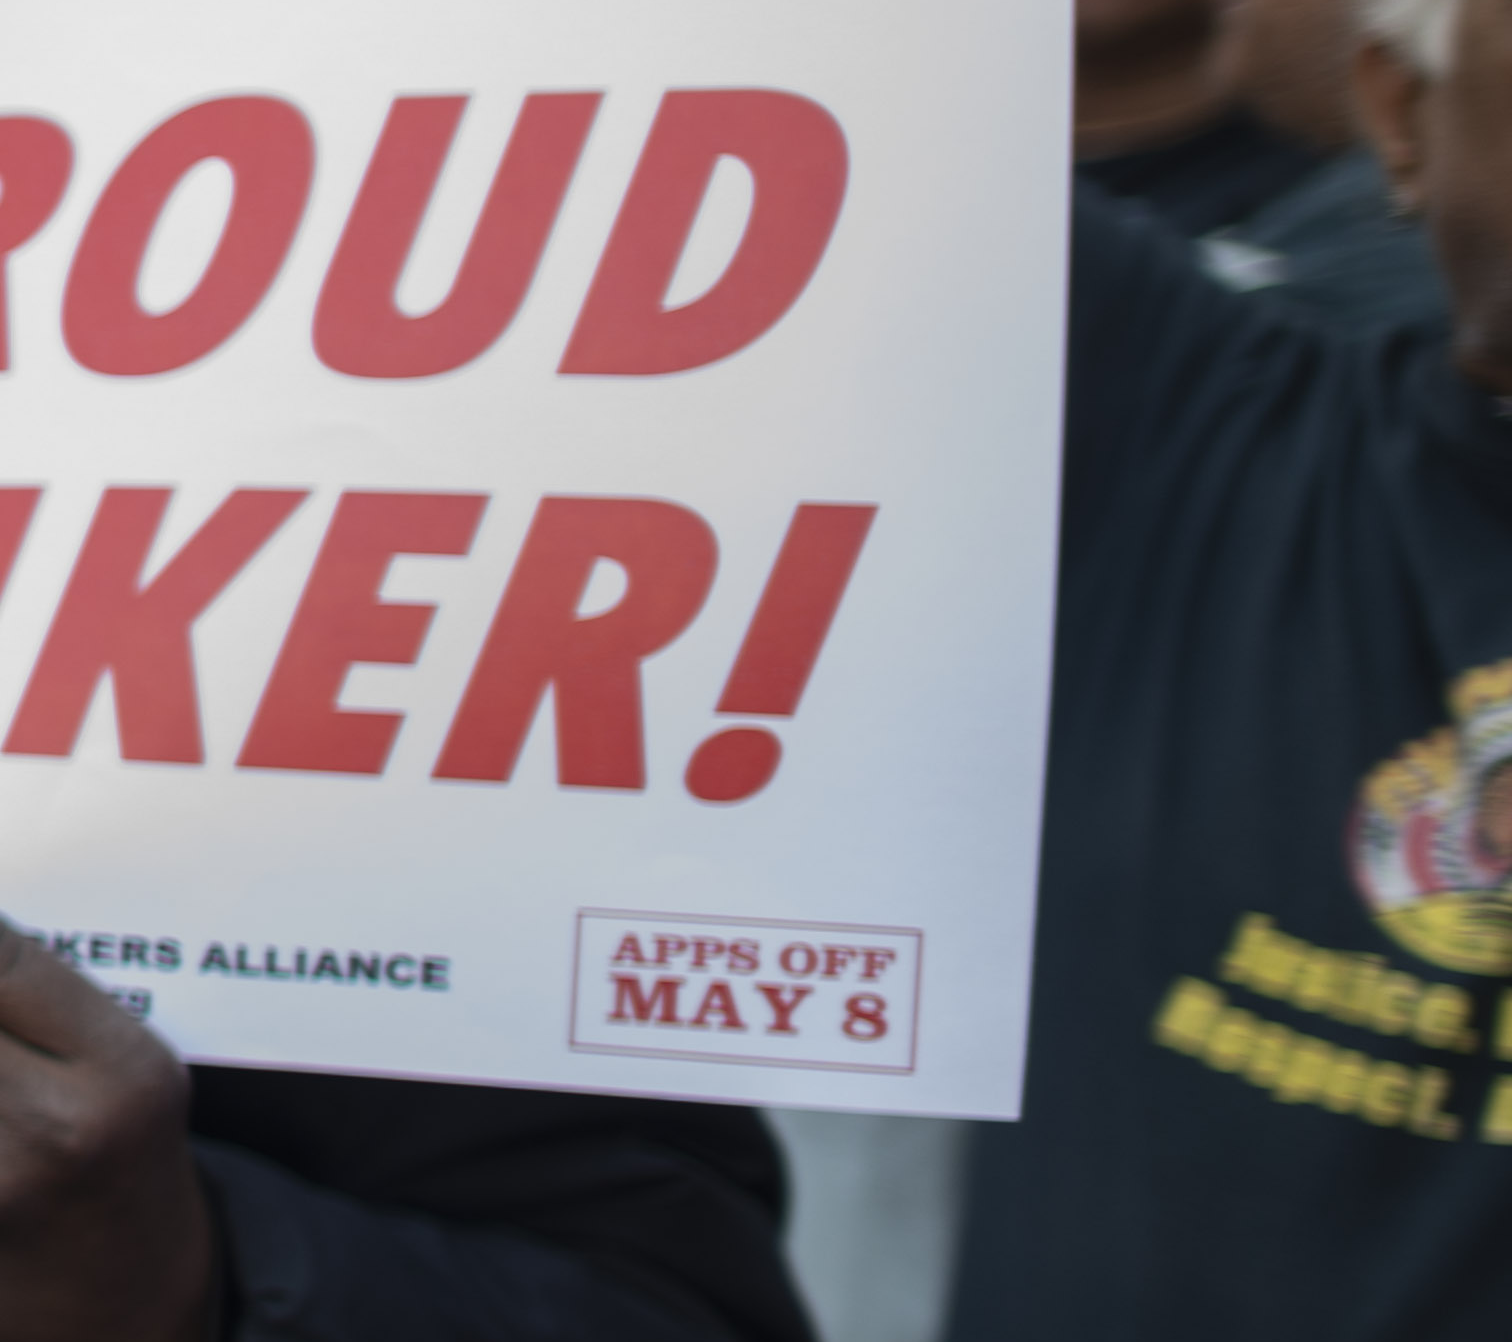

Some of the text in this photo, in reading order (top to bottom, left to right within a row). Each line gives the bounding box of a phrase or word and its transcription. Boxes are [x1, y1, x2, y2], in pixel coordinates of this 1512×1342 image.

[198, 941, 452, 992] ALLIANCE
[611, 932, 897, 981] APPS OFF
[607, 971, 890, 1041] MAY 8
